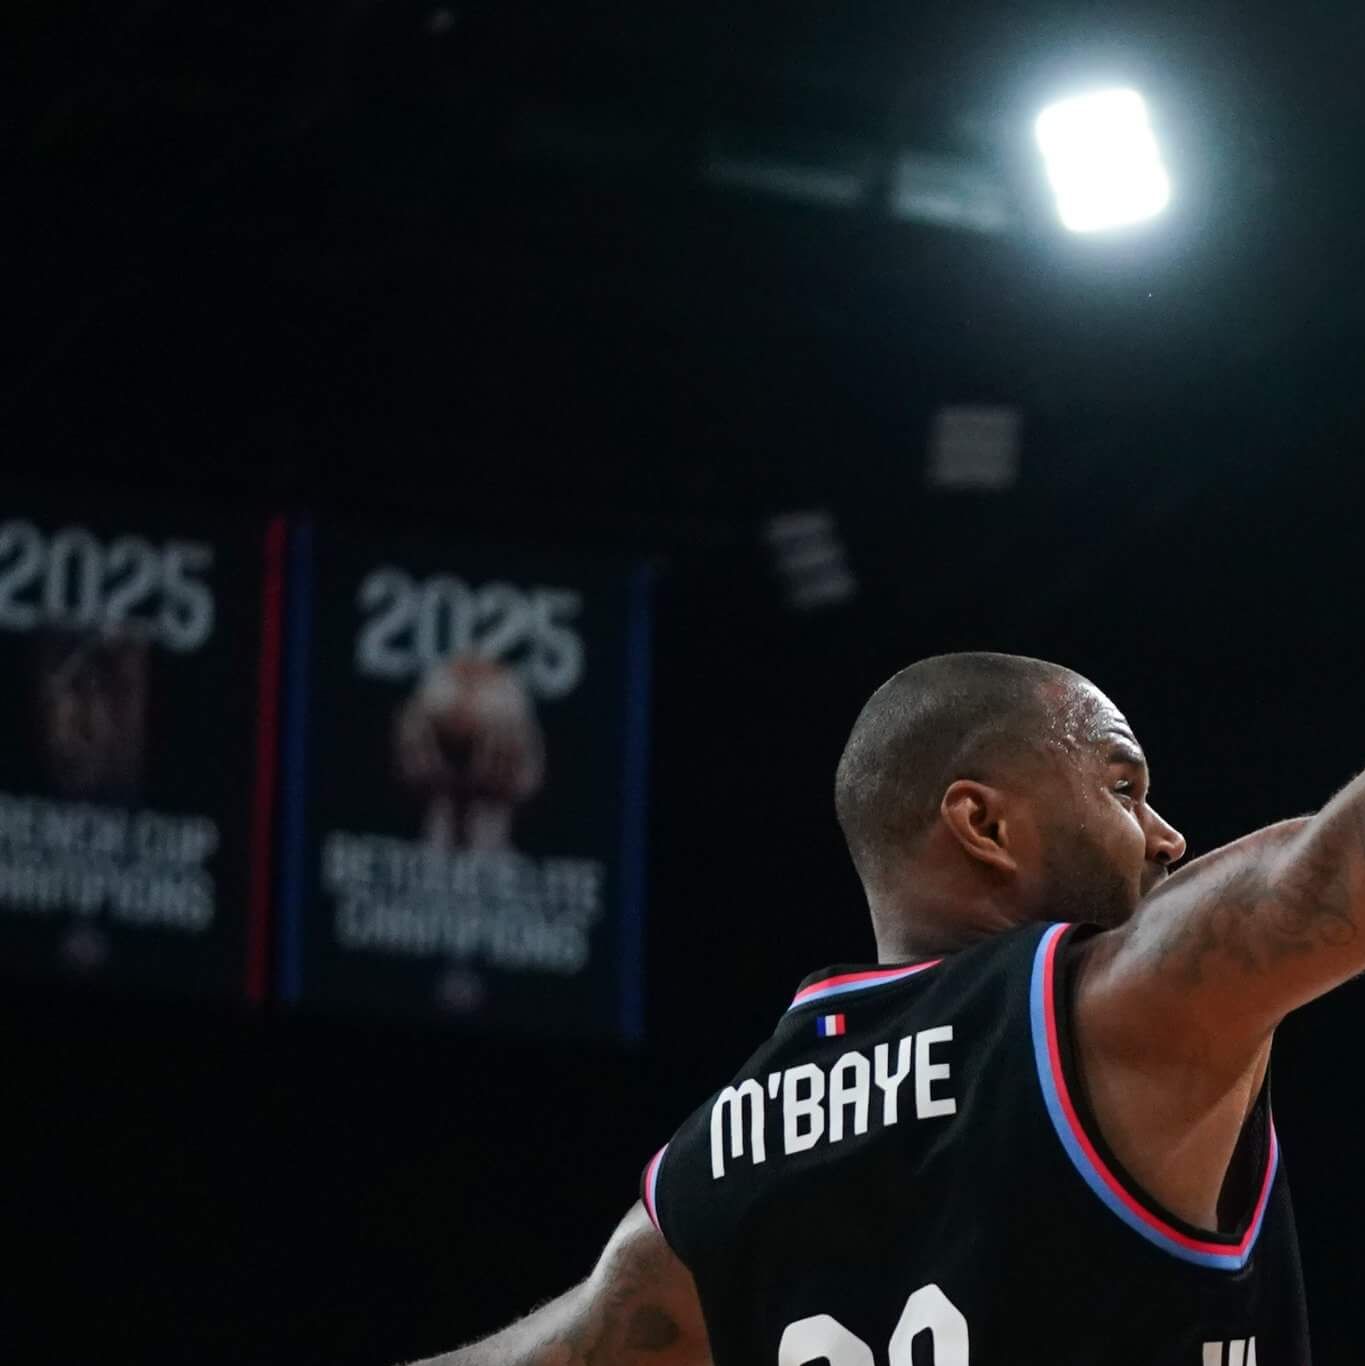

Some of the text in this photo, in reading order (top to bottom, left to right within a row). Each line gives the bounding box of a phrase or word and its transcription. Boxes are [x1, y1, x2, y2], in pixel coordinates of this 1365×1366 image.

[0, 517, 214, 655] 2025
[353, 565, 586, 700] 2025
[709, 1024, 957, 1180] M'BAYE
